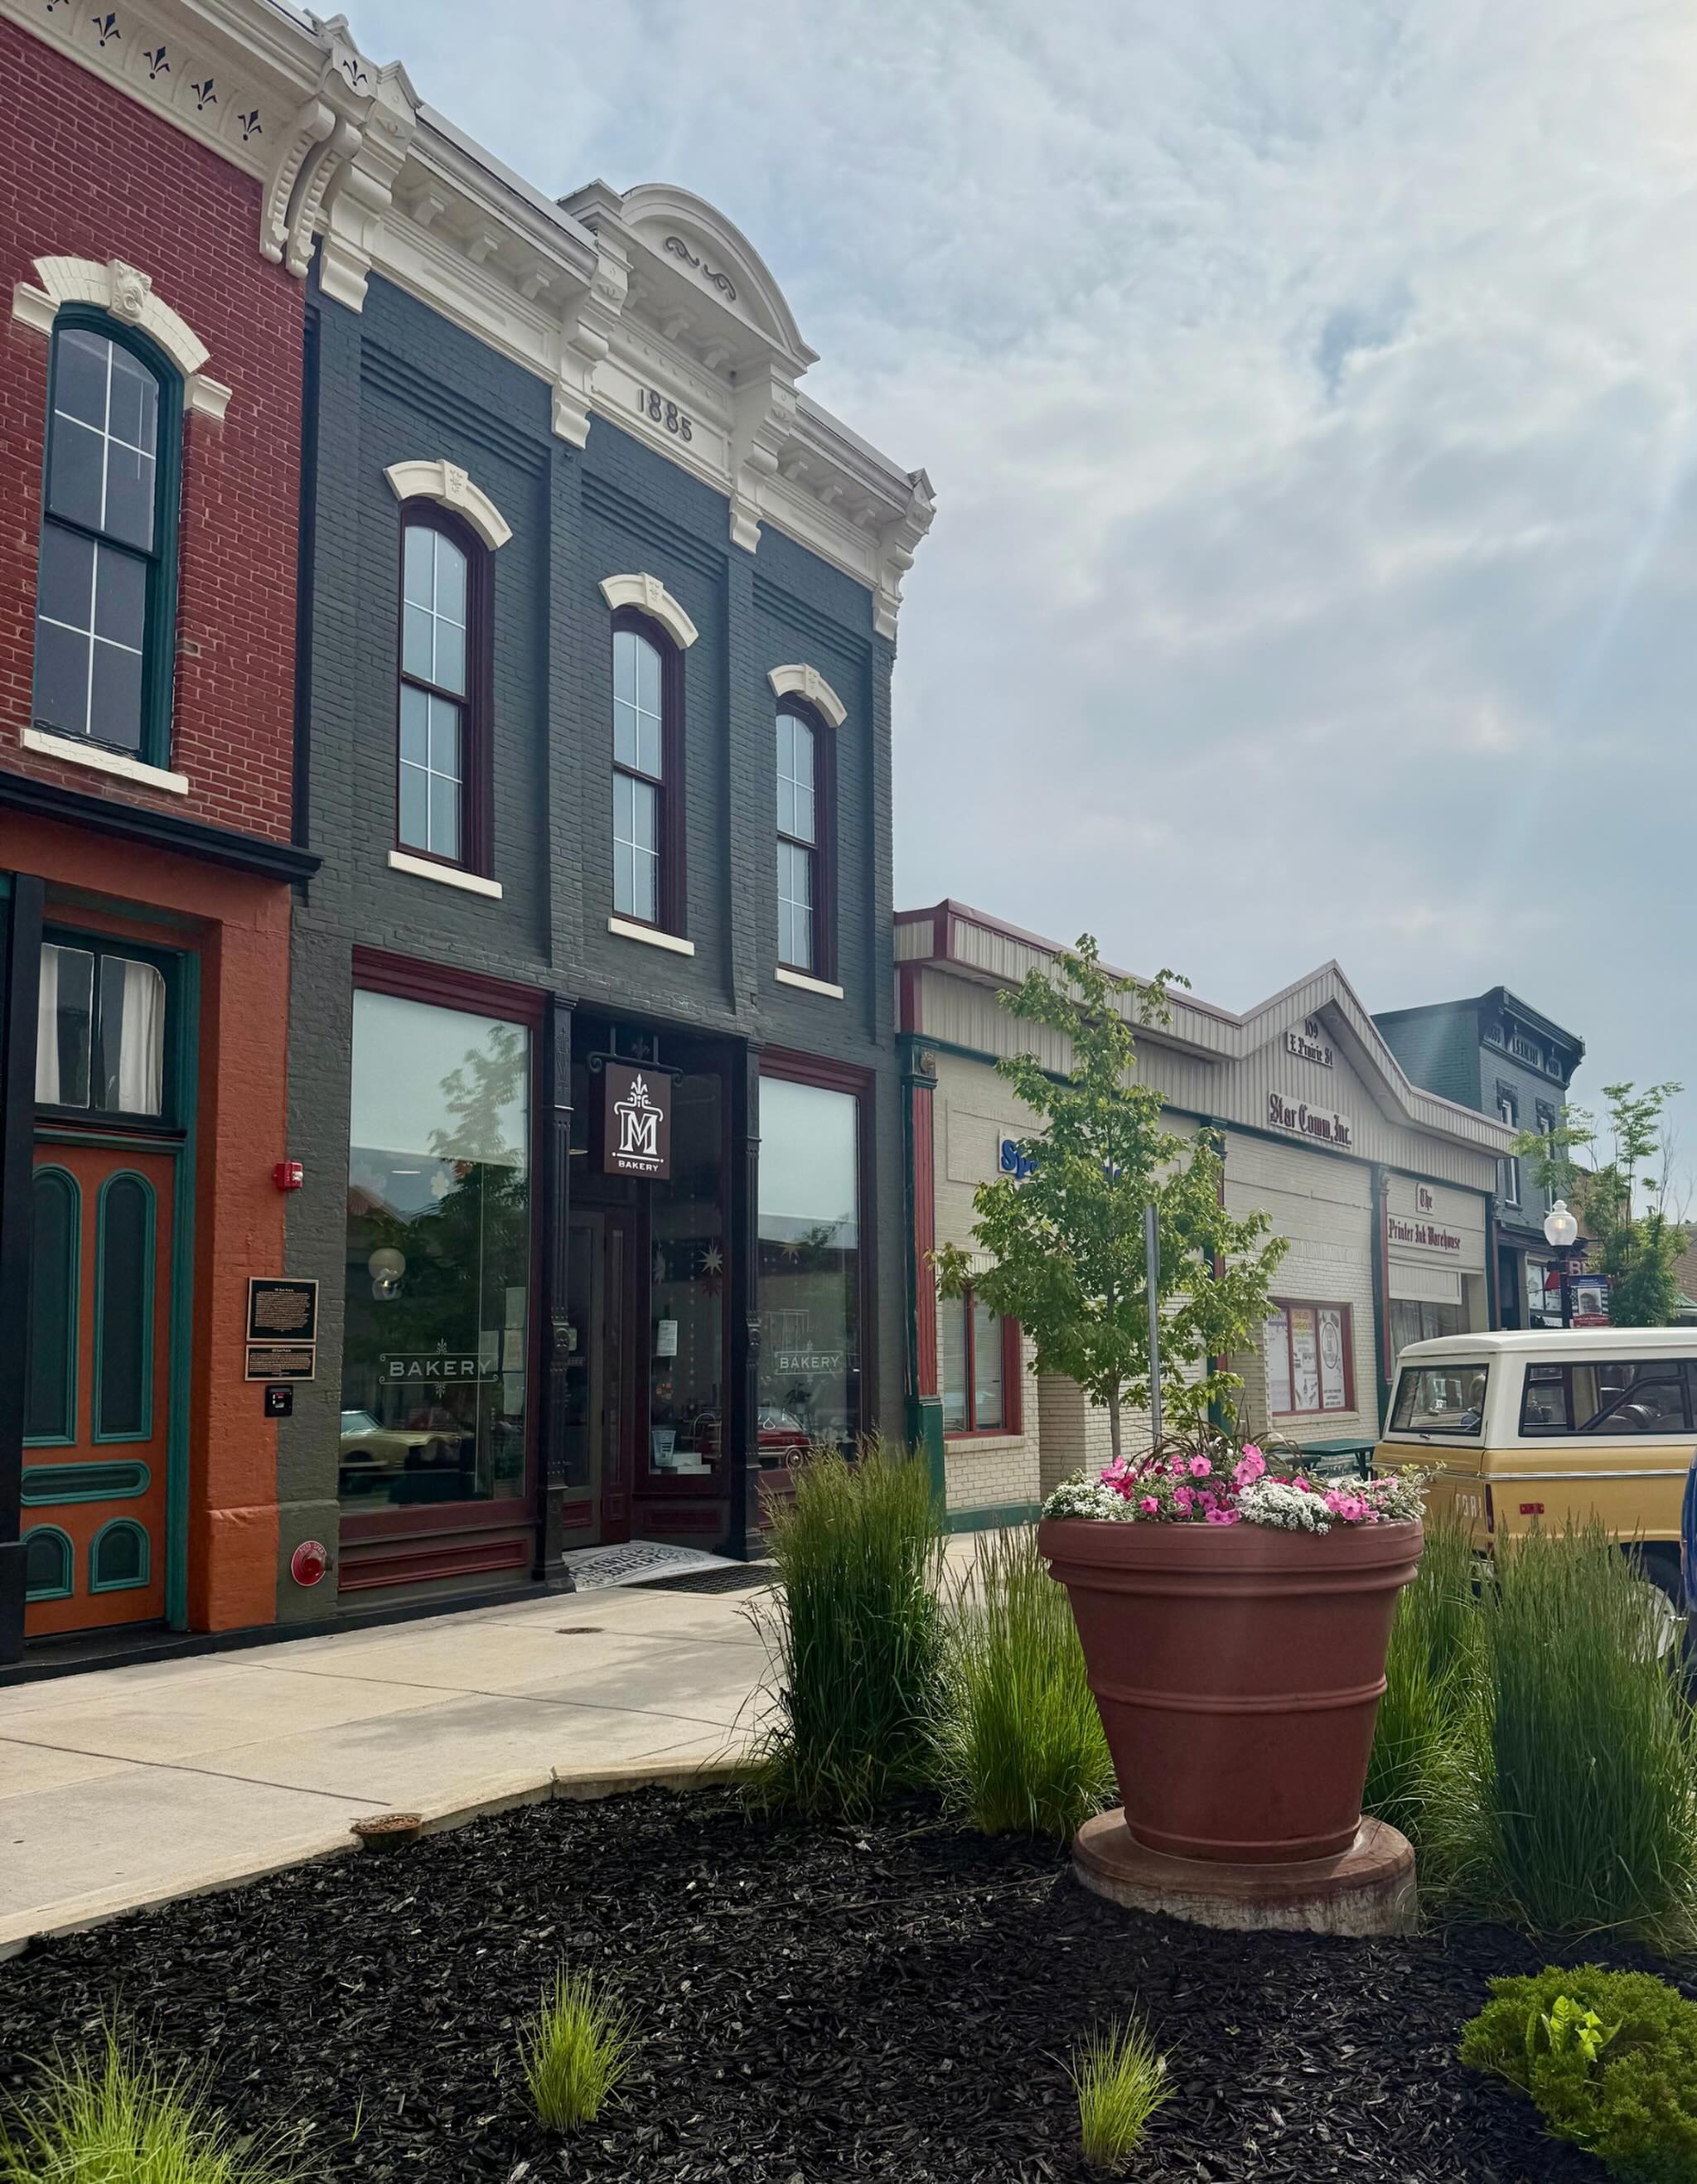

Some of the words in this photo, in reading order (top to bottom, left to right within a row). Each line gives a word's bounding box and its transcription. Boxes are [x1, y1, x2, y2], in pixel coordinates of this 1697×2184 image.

[638, 388, 692, 442] 1885
[1304, 1018, 1318, 1039] 109
[1289, 1033, 1297, 1052] E
[1298, 1036, 1322, 1061] Prairie
[1324, 1046, 1333, 1065] St
[1269, 1093, 1297, 1128] Star
[619, 1109, 658, 1155] M
[618, 1160, 660, 1172] BAKERY
[1419, 1187, 1433, 1211] The
[1388, 1218, 1414, 1242] Printer
[1414, 1224, 1426, 1244] Ink
[1427, 1225, 1461, 1250] Warehouse
[389, 1360, 491, 1377] BAKERY
[780, 1355, 840, 1370] BAKERY
